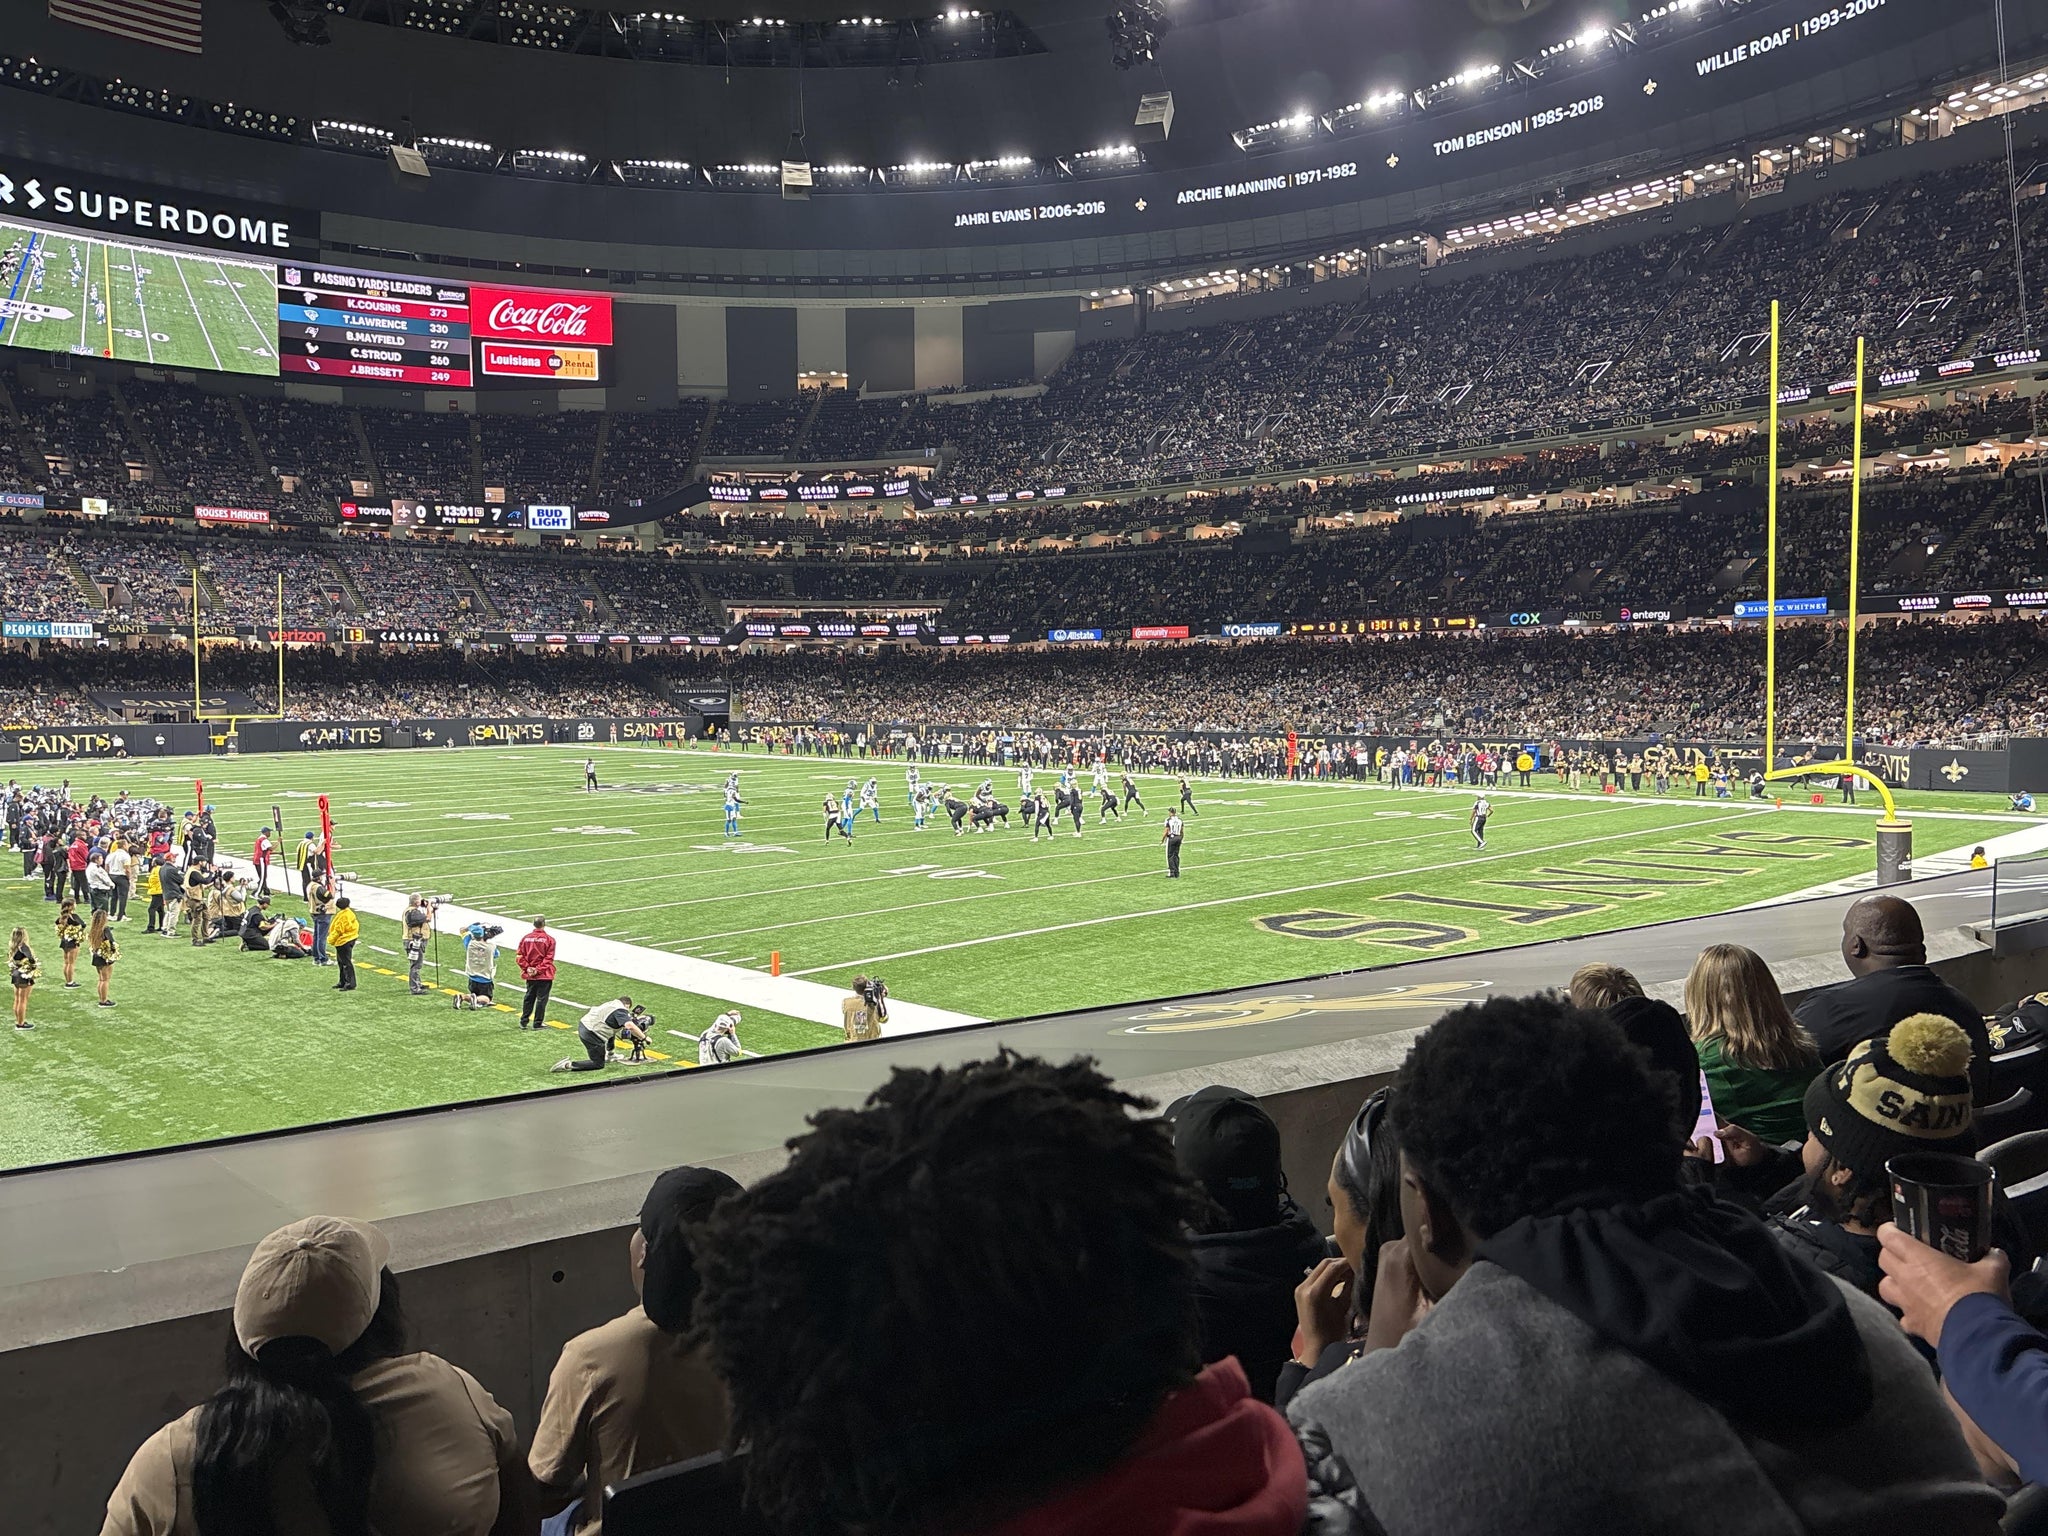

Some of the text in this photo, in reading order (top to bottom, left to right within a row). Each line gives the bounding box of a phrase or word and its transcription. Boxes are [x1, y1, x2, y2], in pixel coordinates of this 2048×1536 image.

[1696, 44, 1747, 77] WILLIE
[1750, 27, 1791, 57] ROAF
[1433, 96, 1603, 156] TOM BENSON 1985-2018
[1177, 162, 1357, 204] ARCHIE MANNING 1971-1982
[54, 187, 290, 248] SUPERDOME
[954, 201, 1106, 227] JAHRI EVANS 2006-2016
[313, 272, 432, 296] PASSING YARDS LEADERS
[3, 301, 26, 309] 2nd
[347, 299, 448, 318] K.COUSINS 373
[489, 299, 592, 336] Coca-Cola
[343, 314, 448, 334] T.LAWRENCE 330
[346, 331, 449, 350] B.MAYFIELD 277
[351, 348, 449, 366] C.STROUD 260
[490, 353, 594, 368] Louisiana CAT Rental
[1993, 349, 2041, 362] CAESARS
[350, 365, 450, 381] J.BRISSETT 249
[1879, 369, 1920, 383] CAESARS
[1777, 387, 1811, 399] AESARS
[1700, 401, 1743, 415] SAINTS
[1613, 414, 1651, 428] SAINTS
[1533, 424, 1569, 438] SAINTS
[1923, 430, 1969, 443] SAINTS
[1457, 438, 1492, 449] SAINTS
[1826, 442, 1868, 456] SAINS
[1387, 447, 1419, 458] SAINTS
[1318, 456, 1349, 466] SAINTS
[1731, 455, 1769, 468] SAINTS
[1255, 463, 1284, 474] SAINTS
[1648, 466, 1684, 477] SAINTS
[1193, 471, 1220, 480] SAINTS
[1569, 476, 1603, 486] SAINTS
[1135, 479, 1161, 488] SAINTS
[1497, 483, 1529, 493] SAINTS
[709, 486, 752, 497] CAESARS
[798, 485, 839, 495] CAESARS
[1077, 485, 1104, 494] SAINTS
[1394, 486, 1495, 504] CAESARS SUPERDOME
[7, 494, 42, 506] GLOBAL
[1366, 497, 1395, 506] SAINTS
[146, 503, 182, 513] SAINTS
[358, 506, 392, 517] TOYOTA
[416, 505, 427, 519] 0
[443, 506, 474, 517] 13:01
[537, 508, 562, 518] BUD
[1303, 503, 1331, 512] SAINTS
[196, 507, 268, 521] ROUSES MARKETS
[303, 513, 335, 522] SAINTS
[491, 508, 501, 521] 7
[1184, 515, 1210, 523] SAINTS
[1242, 509, 1269, 518] SAINTS
[532, 517, 568, 527] LIGHT
[1125, 520, 1151, 528] SAINTS
[1071, 524, 1096, 532] SAINTS
[1899, 597, 1940, 607] CAESARS
[2005, 591, 2048, 602] CAESARS
[1748, 603, 1827, 613] HANCCK WHITNEY
[1509, 612, 1540, 625] COX
[1567, 610, 1602, 620] SAINTS
[1632, 610, 1670, 621] entergy
[5, 624, 90, 636] PEOPLES HEALTH
[108, 624, 148, 634] SAINTS
[198, 625, 236, 635] SAINTS
[746, 624, 775, 633] CAESARS
[817, 624, 856, 633] CAESARS
[1105, 629, 1130, 638] SAINTS
[1135, 627, 1168, 638] Community
[1231, 624, 1280, 637] Ochsner
[268, 629, 326, 642] verizon
[350, 629, 363, 640] 13
[380, 631, 440, 642] CAESARS
[448, 630, 480, 640] SAINTS
[1067, 630, 1096, 640] Allstate
[121, 698, 227, 708] SAINTS
[312, 727, 382, 745] AINTS
[1250, 831, 1877, 952] SAINTS
